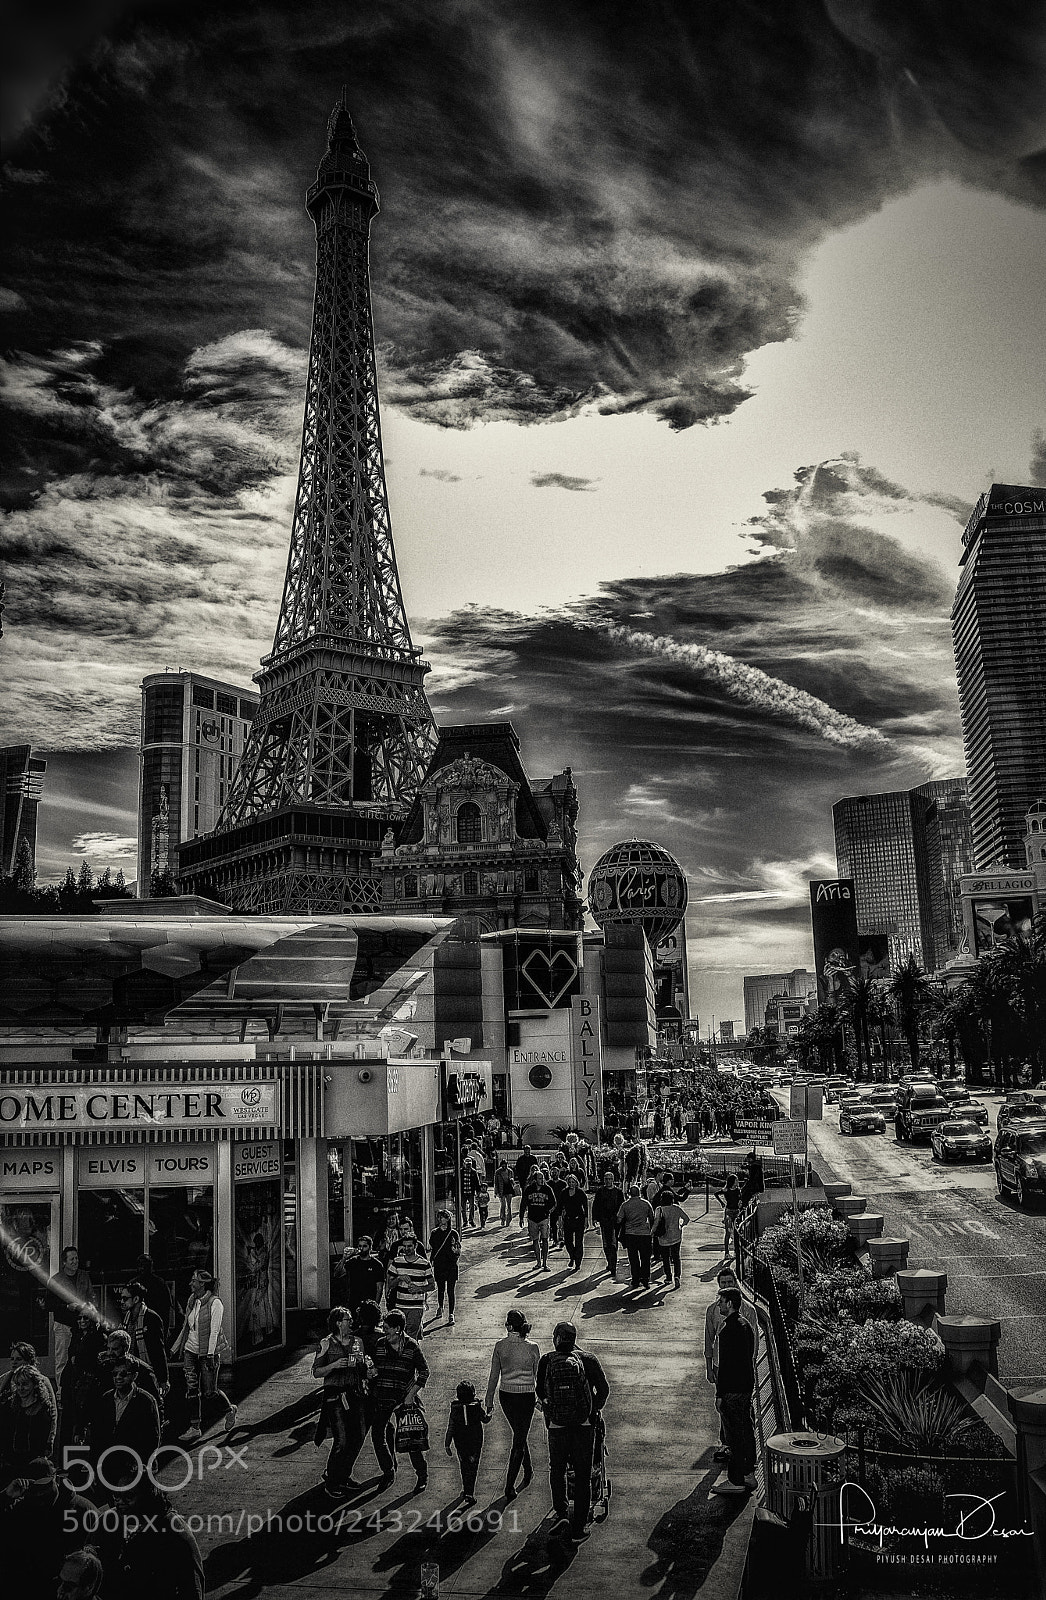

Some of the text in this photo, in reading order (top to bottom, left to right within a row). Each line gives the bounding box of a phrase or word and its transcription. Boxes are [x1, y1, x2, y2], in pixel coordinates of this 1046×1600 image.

[1004, 501, 1046, 514] COSM
[616, 867, 656, 913] Paris
[816, 882, 851, 902] Aria
[968, 879, 1033, 892] BELLAGIO
[514, 1050, 567, 1063] ENTRANCE
[580, 999, 596, 1117] BALLYS
[86, 1092, 226, 1119] CENTER
[735, 1120, 772, 1129] VAPOR KIN
[241, 1145, 274, 1160] GUEST
[3, 1161, 54, 1176] MAPS
[88, 1157, 209, 1174] ELVIS TOURS
[235, 1160, 280, 1177] SERVICES
